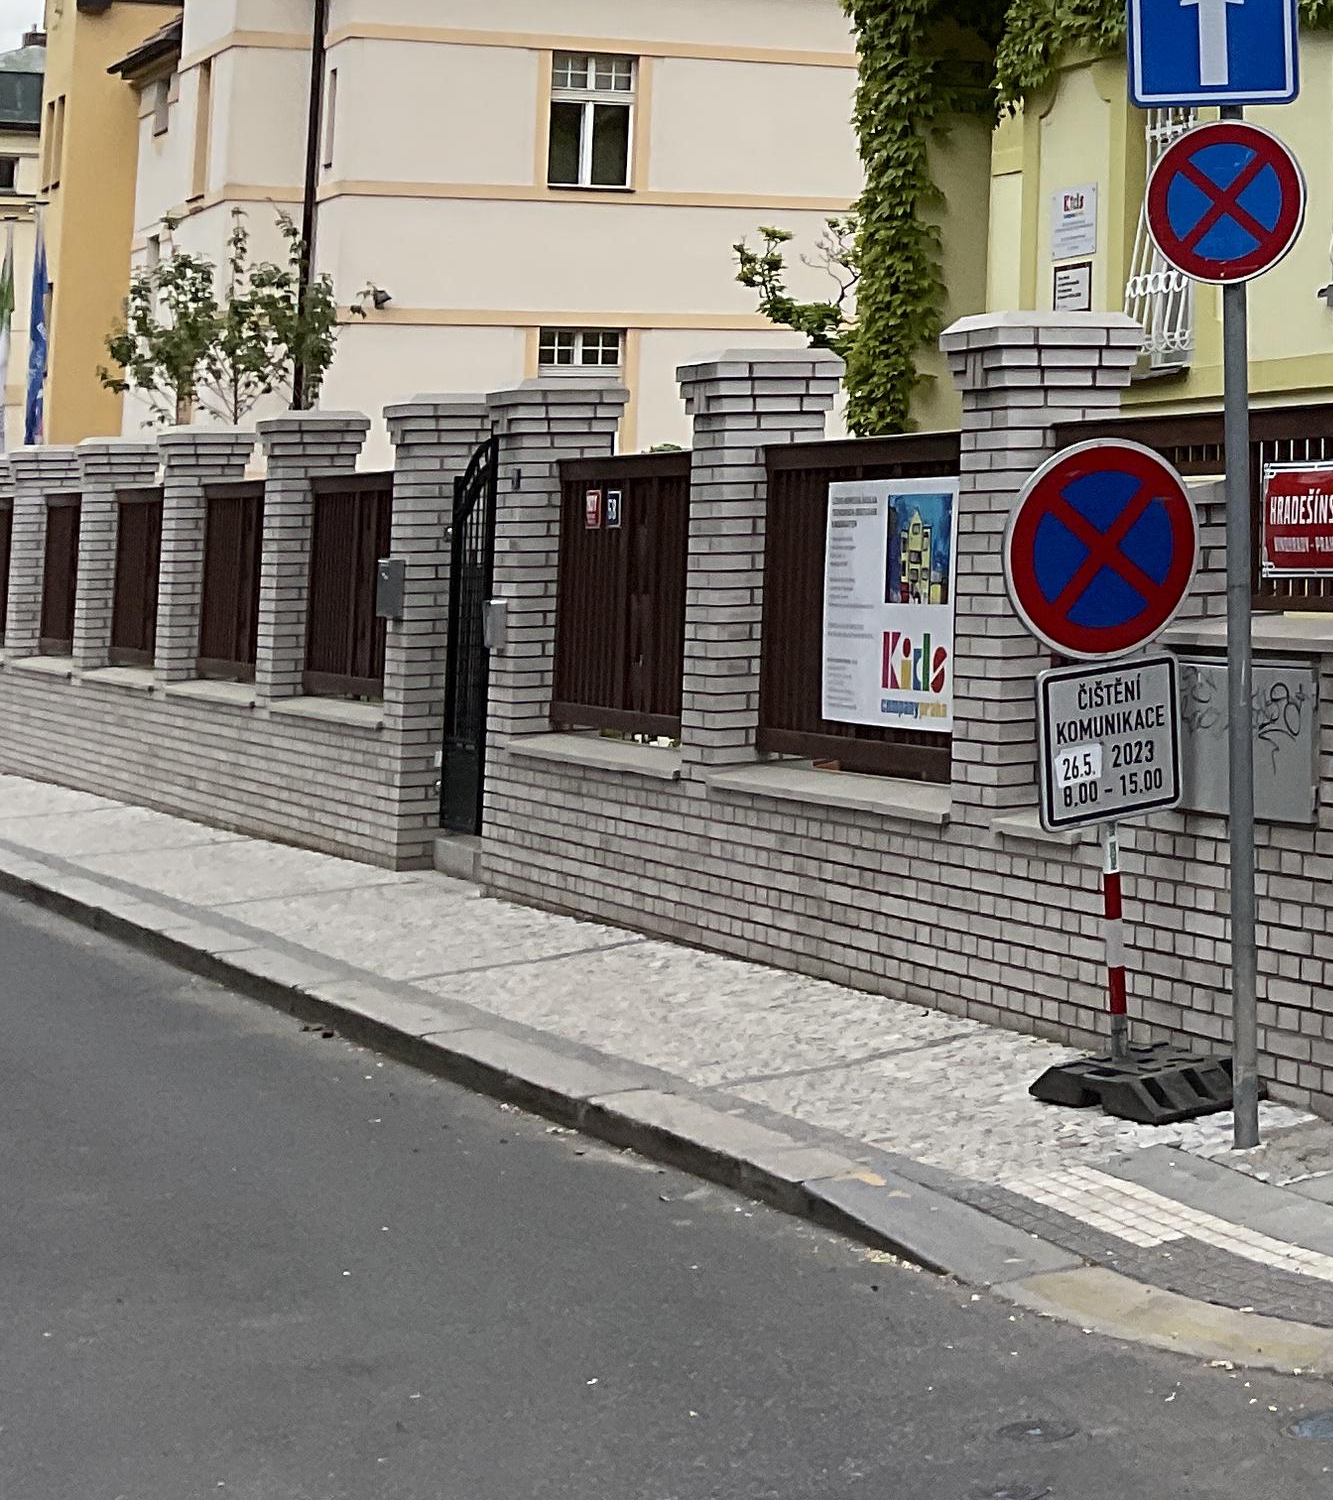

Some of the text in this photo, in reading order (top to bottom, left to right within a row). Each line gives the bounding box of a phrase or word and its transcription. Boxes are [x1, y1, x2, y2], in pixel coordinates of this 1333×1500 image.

[881, 631, 948, 694] Kids
[1077, 673, 1141, 710] ČIŠTĚNÍ
[1056, 705, 1165, 745] KOMUNIKACE
[1062, 739, 1156, 783] 26.5. 2023
[1119, 767, 1163, 797] 15.00
